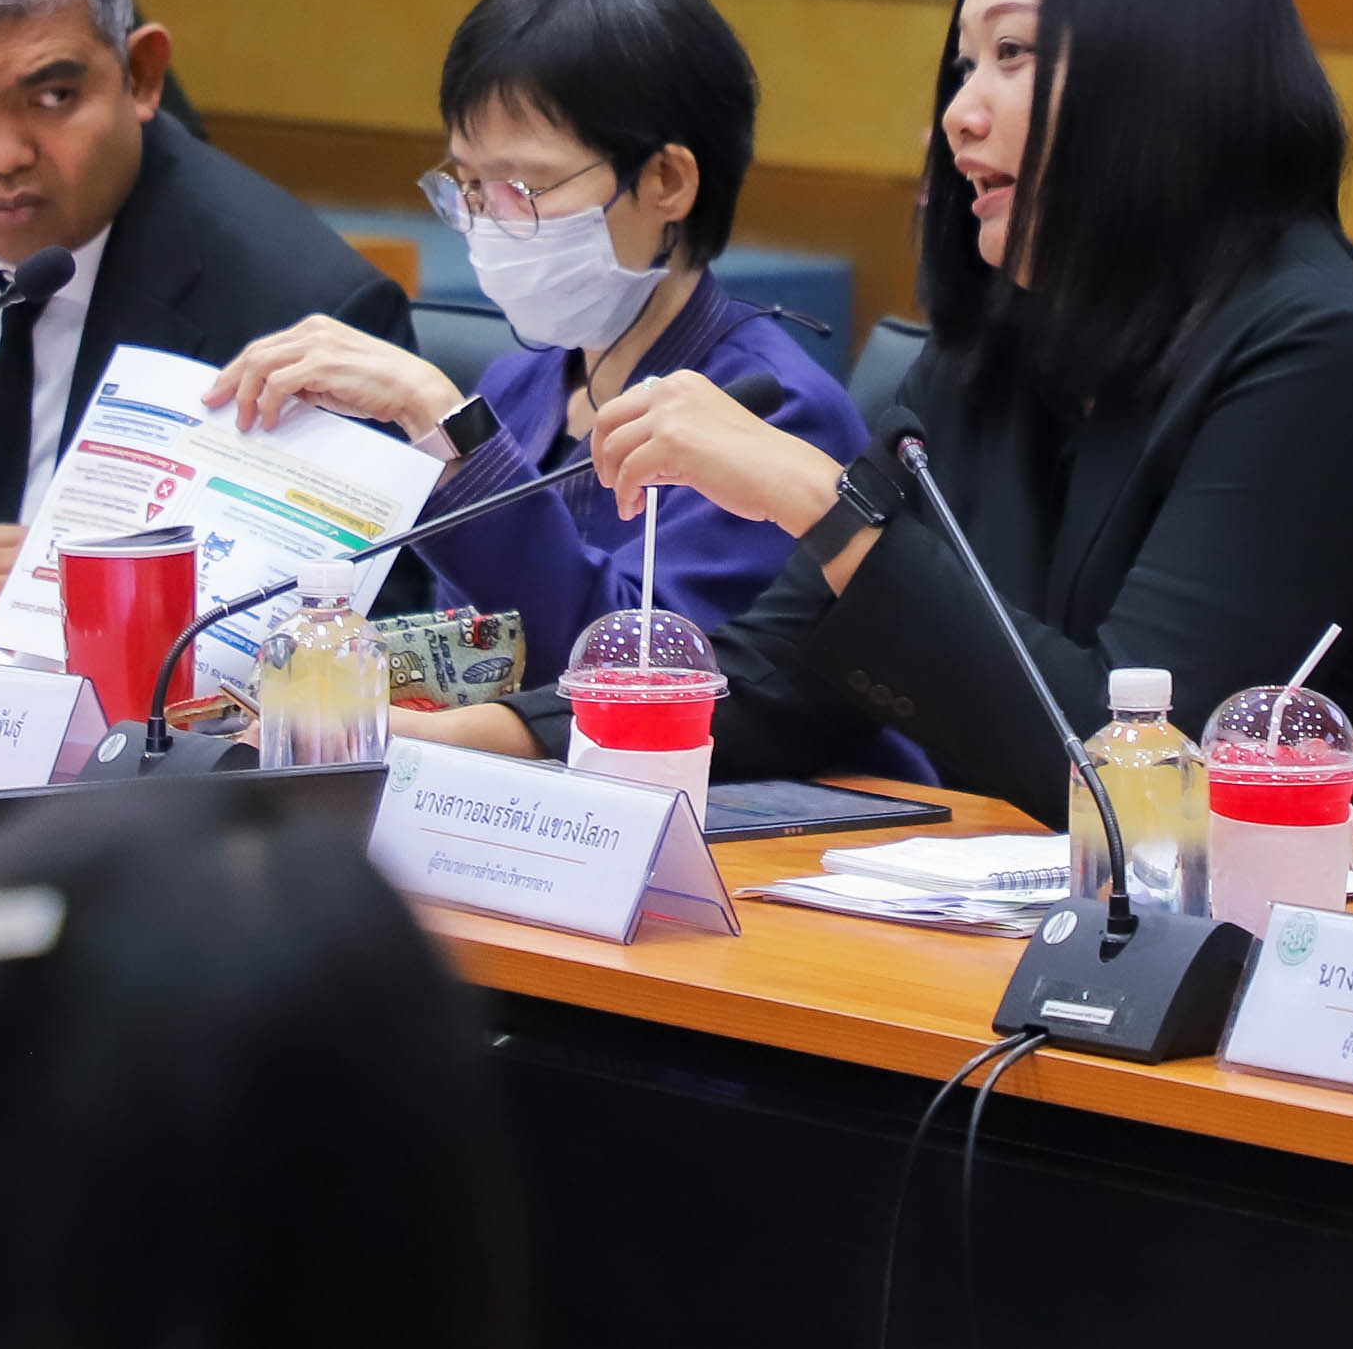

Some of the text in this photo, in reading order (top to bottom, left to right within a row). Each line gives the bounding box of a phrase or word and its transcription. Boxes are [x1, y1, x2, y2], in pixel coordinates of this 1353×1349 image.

[415, 789, 621, 851] นางสาวอมรรัตน์ แขวงโสภา
